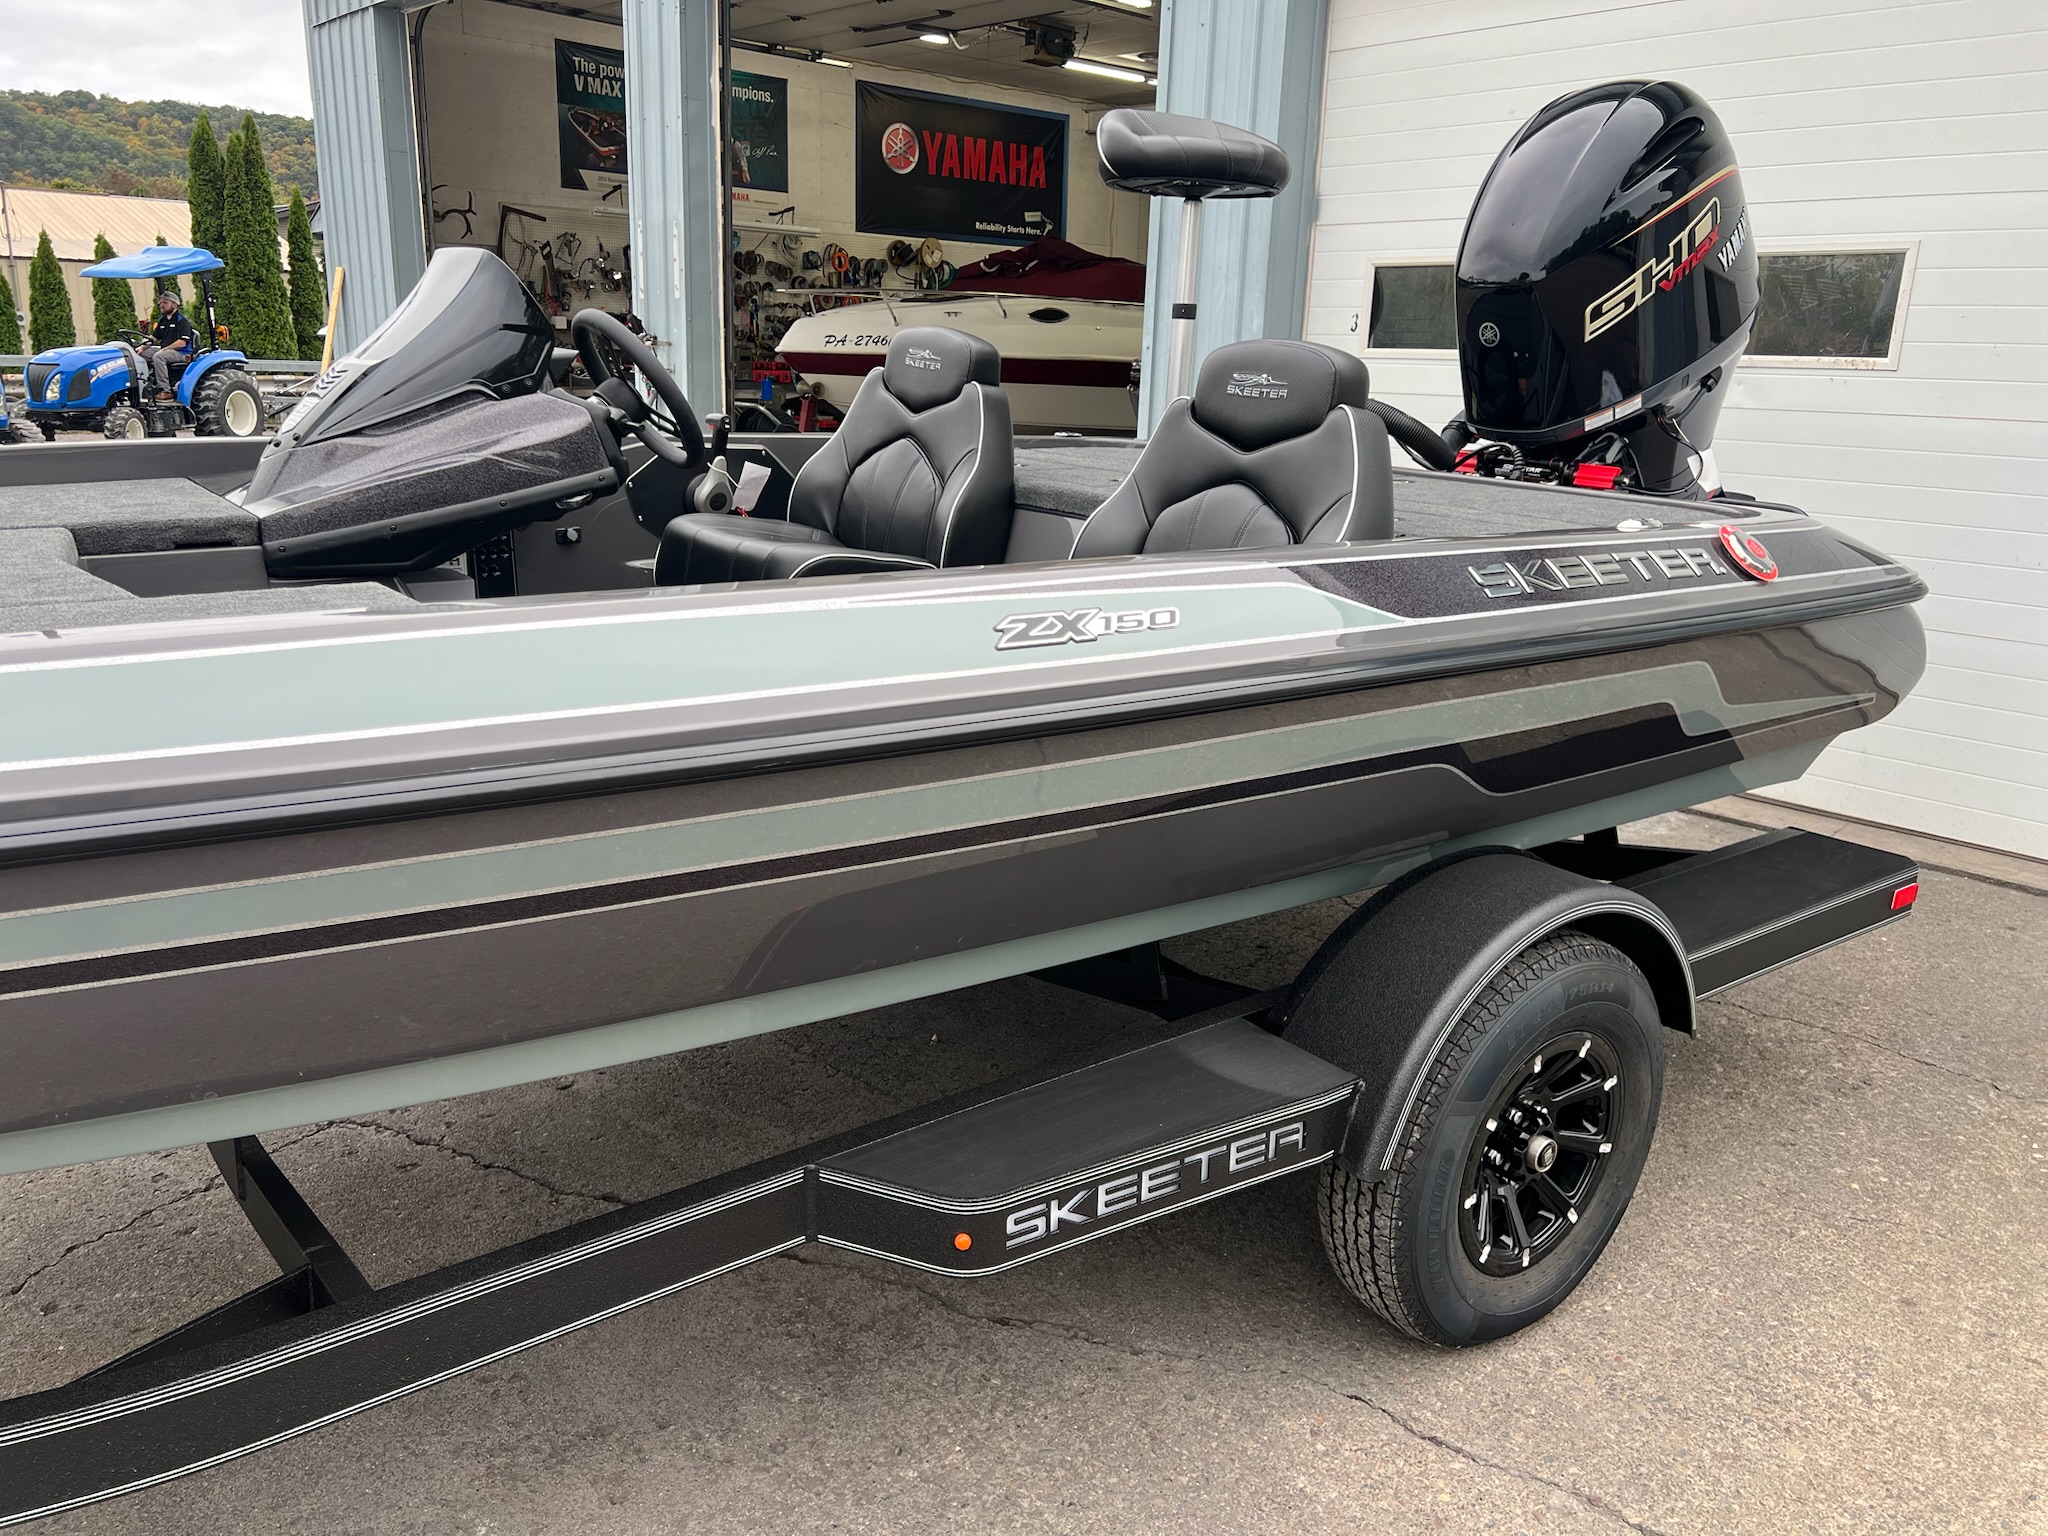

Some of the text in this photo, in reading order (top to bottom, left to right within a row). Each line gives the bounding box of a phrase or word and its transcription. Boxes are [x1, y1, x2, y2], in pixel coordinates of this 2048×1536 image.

[573, 56, 596, 75] The
[573, 74, 622, 98] V MAX
[922, 129, 1047, 189] YAMAHA
[975, 221, 1042, 236] Reliability Starts Here.
[1717, 206, 1748, 273] YAMAH
[1350, 312, 1359, 333] 3
[904, 356, 942, 371] SKEETER
[1226, 384, 1288, 400] SKEETER
[1467, 547, 1723, 599] SKEETER
[1005, 1120, 1306, 1250] SKEETER
